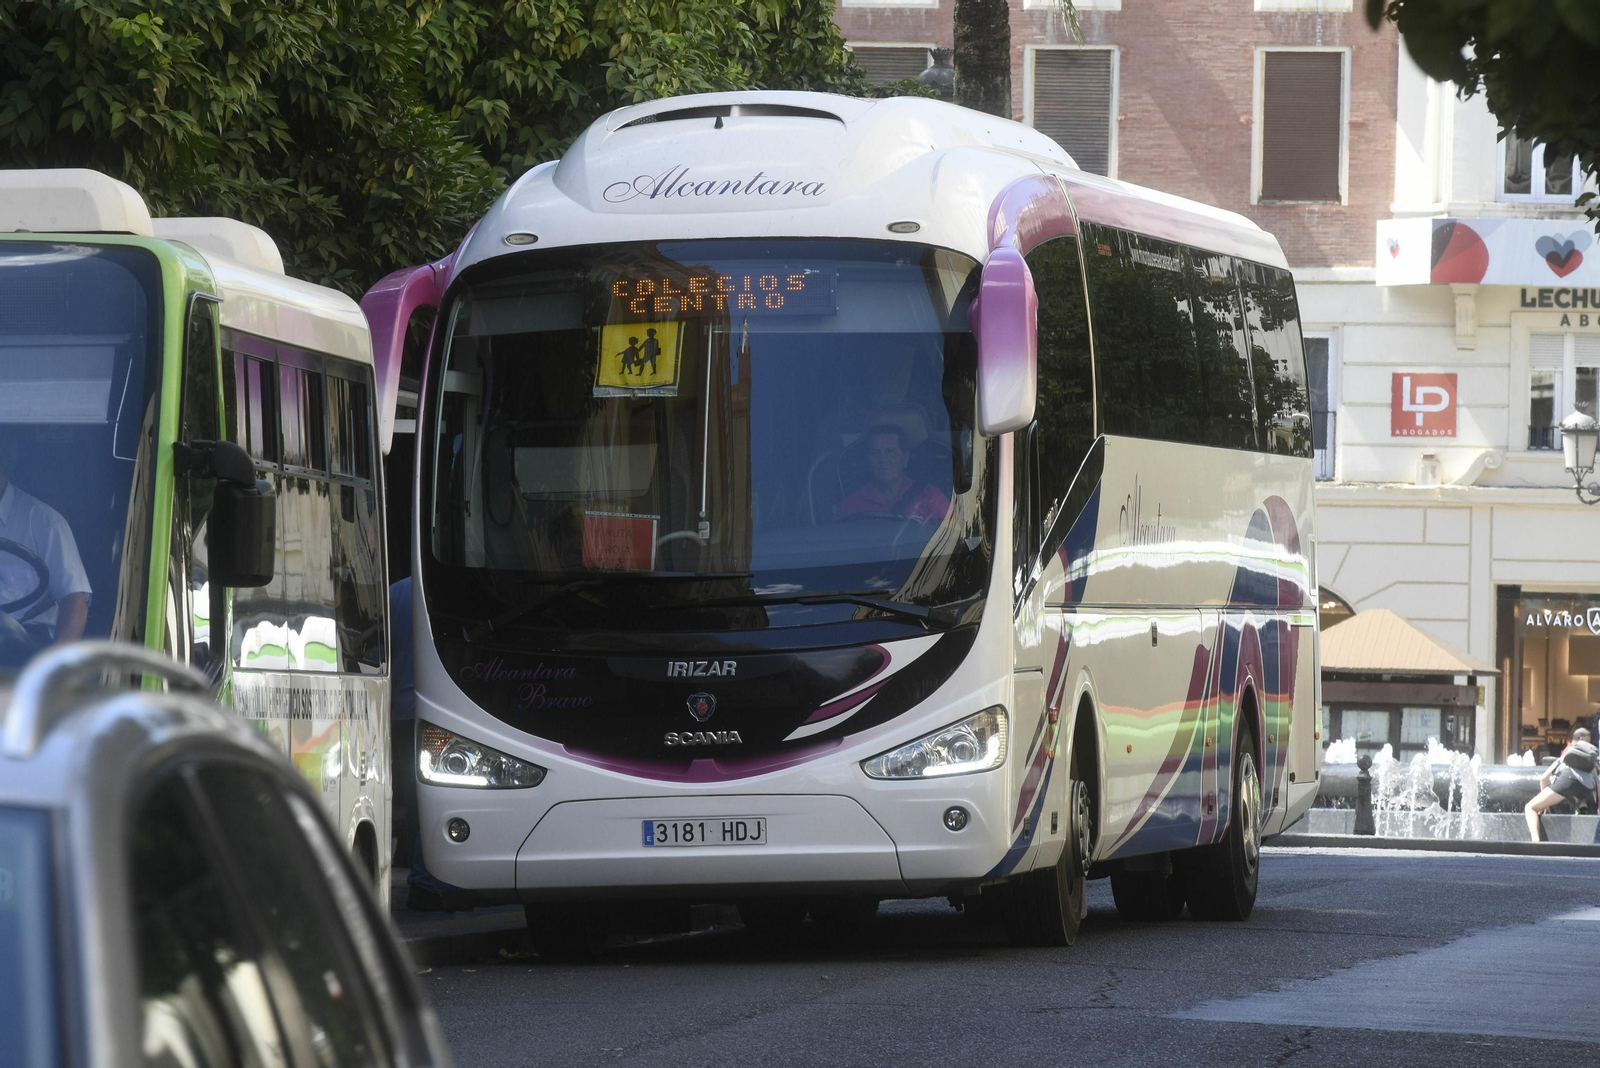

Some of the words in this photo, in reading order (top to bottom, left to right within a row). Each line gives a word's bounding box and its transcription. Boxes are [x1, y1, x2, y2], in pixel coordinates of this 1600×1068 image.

[603, 164, 826, 203] Alcantara
[613, 274, 805, 297] COLEGIOS
[630, 293, 784, 313] CENTRO
[1561, 314, 1600, 327] AB
[1395, 428, 1453, 436] ABOGADOS
[605, 529, 633, 538] RUTA
[605, 545, 631, 555] ROJA
[1526, 613, 1584, 627] ALVARO
[460, 656, 576, 683] Alcantara
[666, 660, 737, 677] IRIZAR
[517, 682, 594, 711] Bravo
[664, 730, 743, 747] SCANIA
[656, 823, 706, 843] 3181
[722, 821, 762, 843] HDJ
